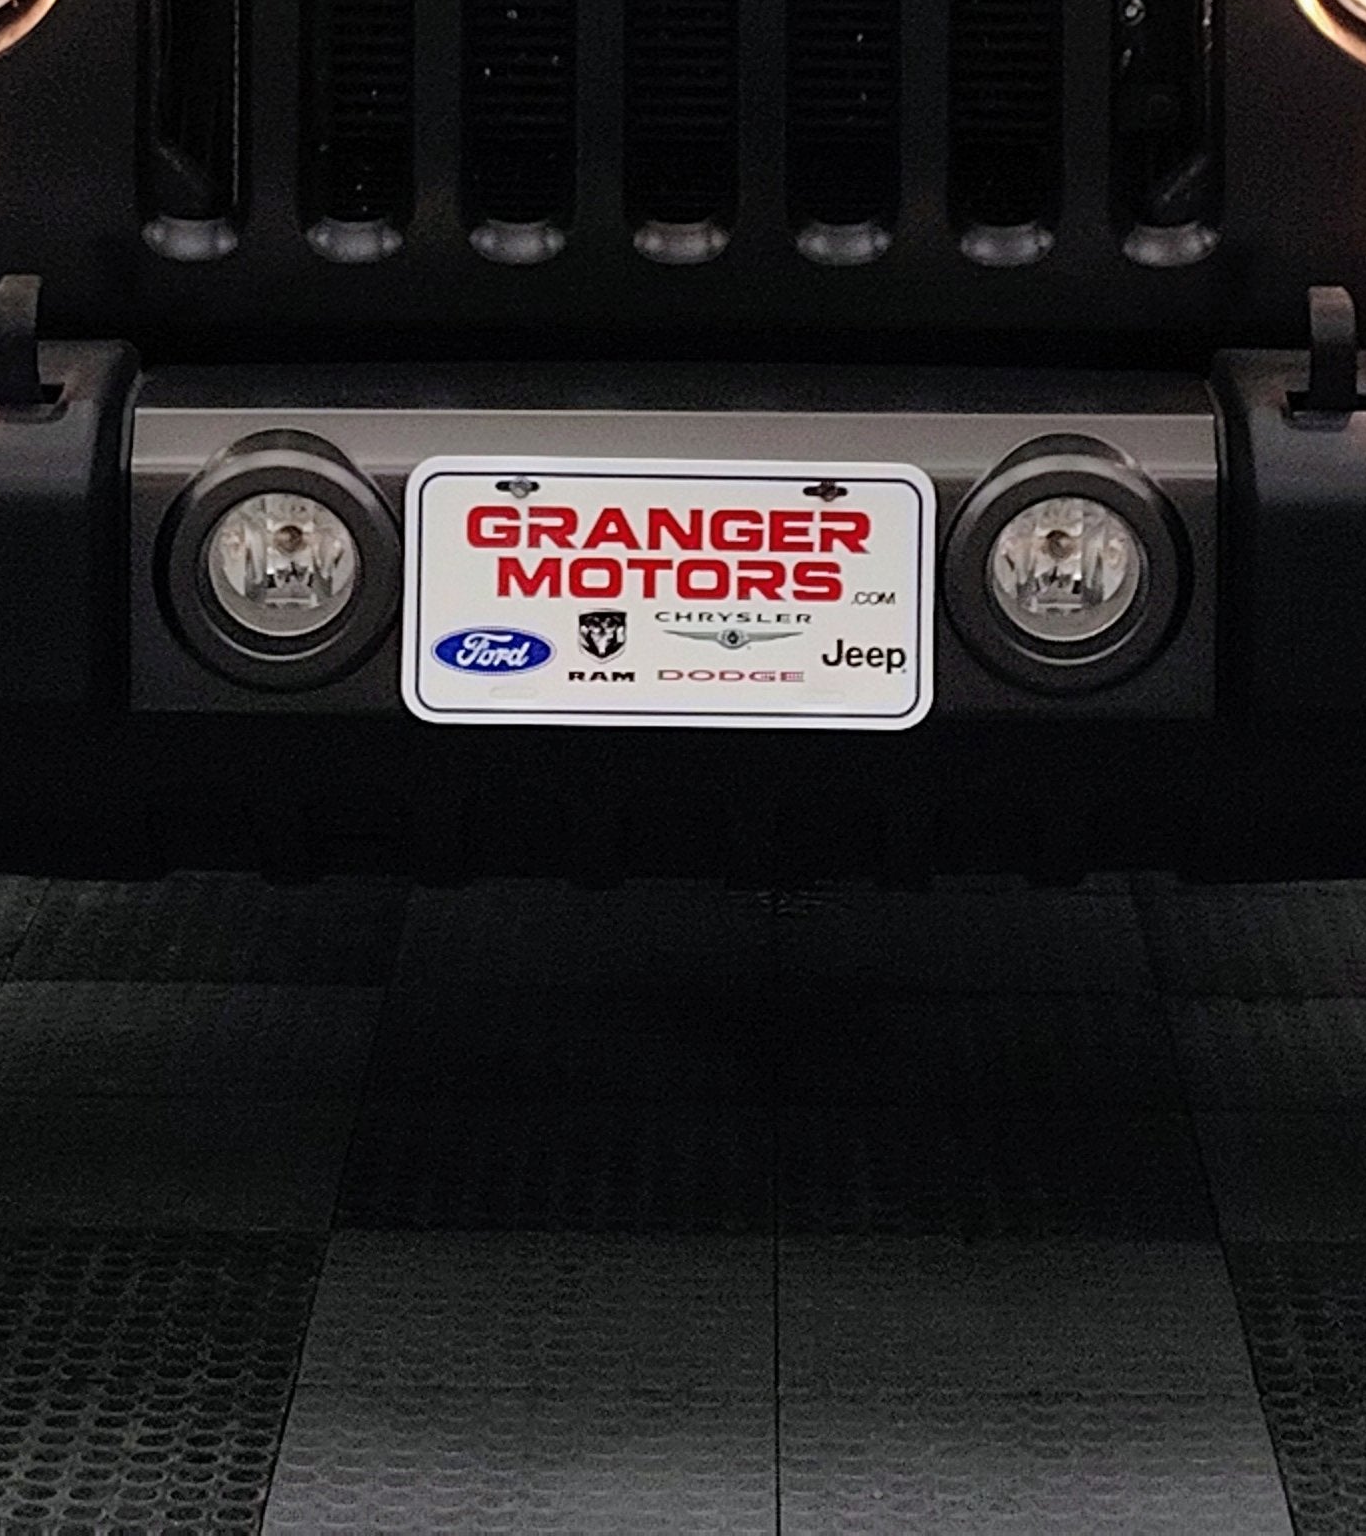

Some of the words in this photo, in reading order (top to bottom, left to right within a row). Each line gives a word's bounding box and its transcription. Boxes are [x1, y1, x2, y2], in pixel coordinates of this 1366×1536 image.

[466, 505, 871, 554] GRANGER
[497, 557, 843, 601] MOTORS
[654, 611, 812, 624] CHRYSLER
[456, 634, 528, 667] Ford
[822, 639, 906, 674] Jeep
[568, 671, 635, 682] RAM
[657, 669, 804, 682] DODGE
